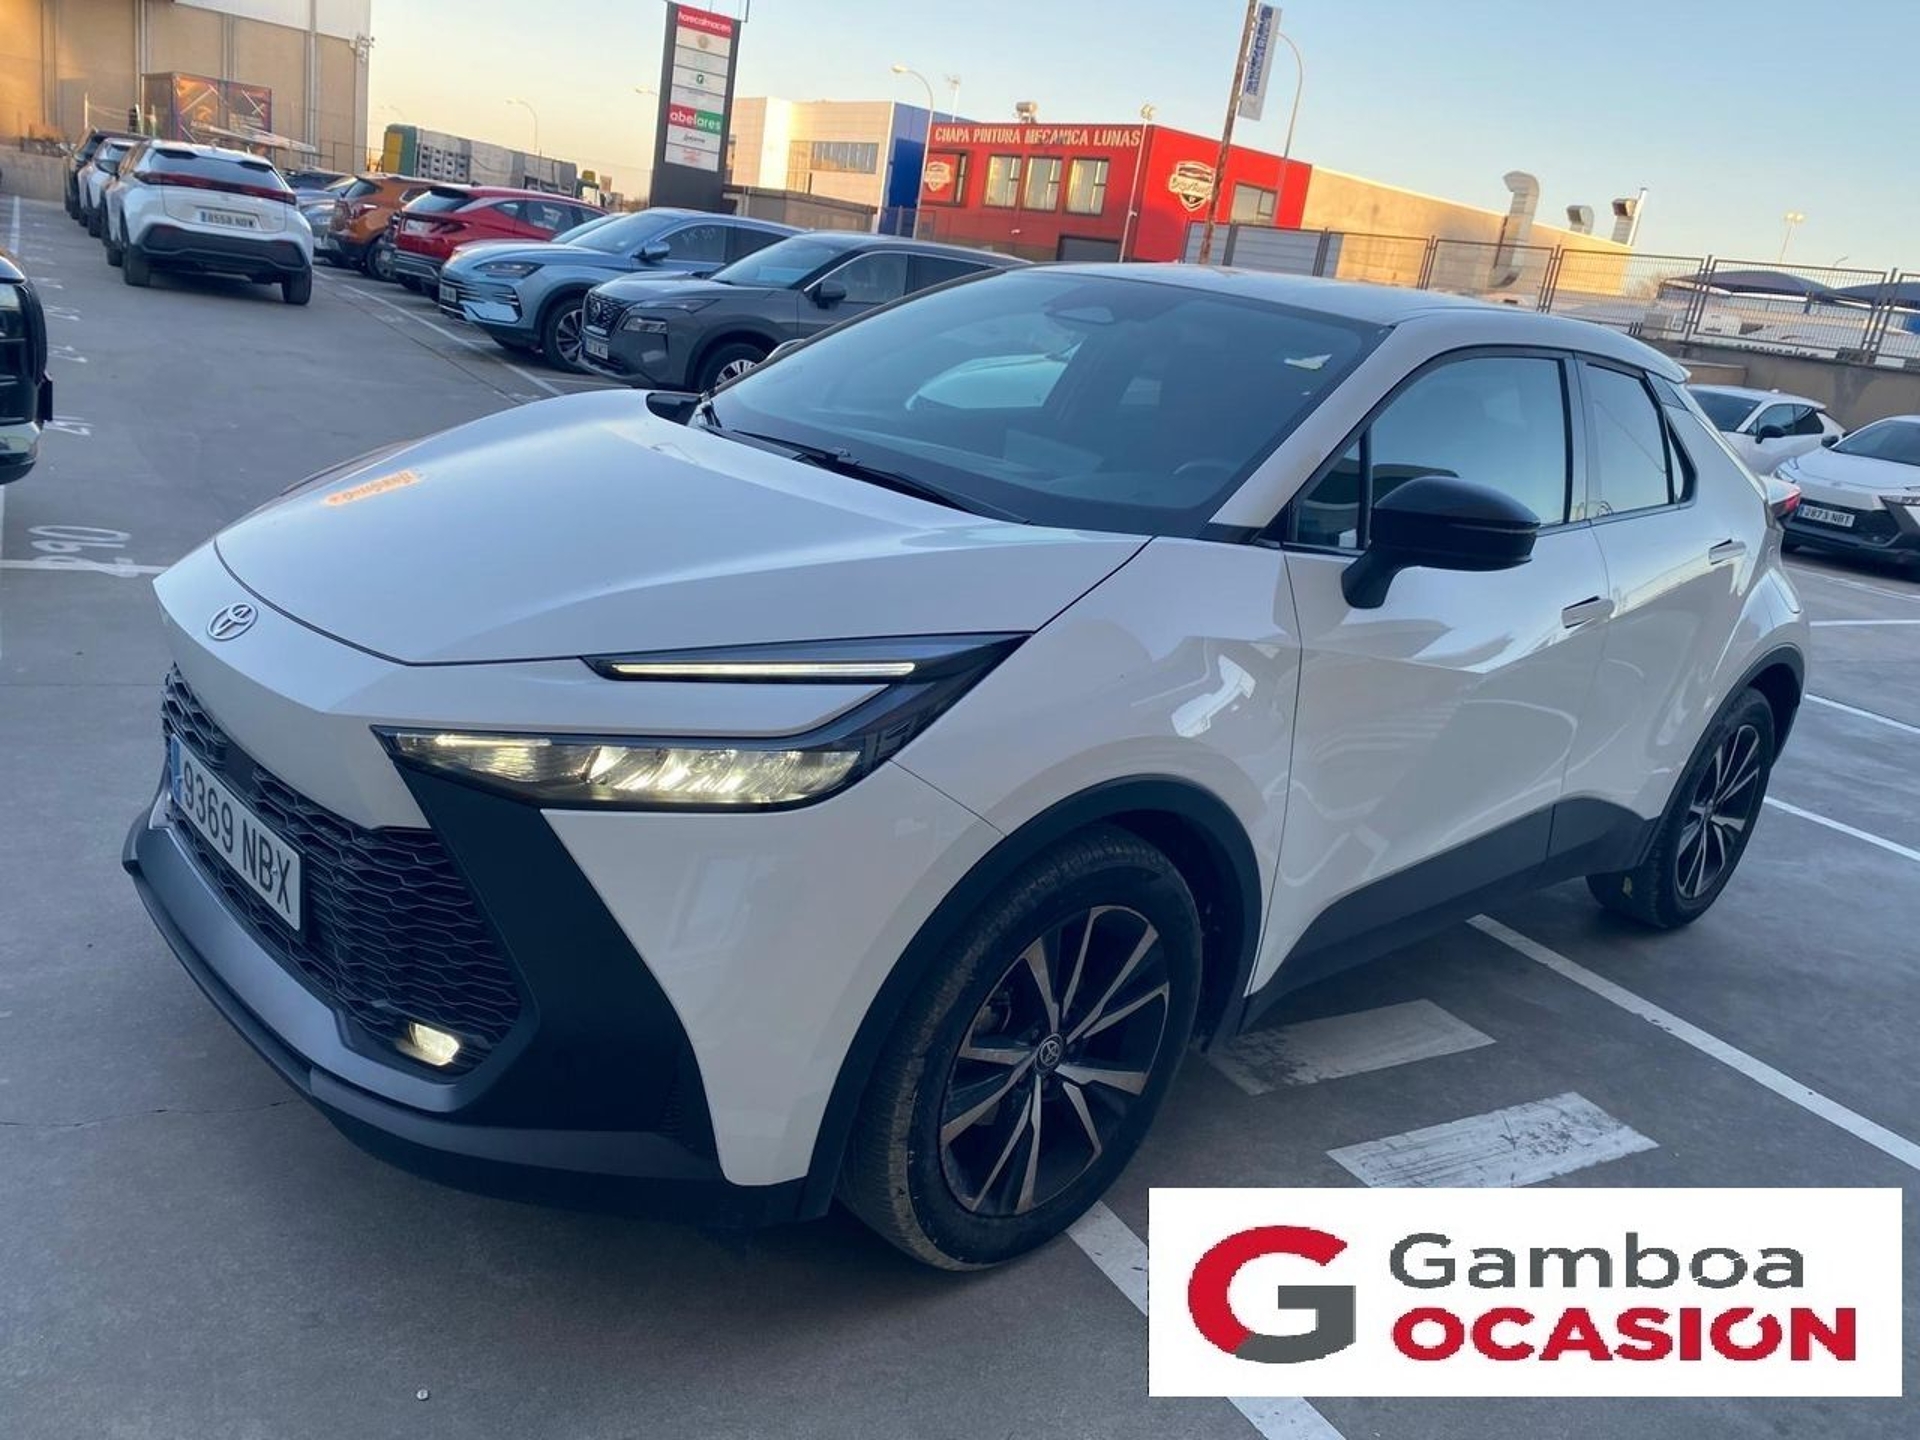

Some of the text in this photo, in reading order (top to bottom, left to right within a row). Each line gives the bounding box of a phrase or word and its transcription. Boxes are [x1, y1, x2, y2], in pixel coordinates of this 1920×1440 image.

[670, 110, 721, 130] abelares
[935, 126, 1142, 147] CHAPA PINTURA MECANICA LUNAS
[184, 761, 291, 914] 9369 NBX
